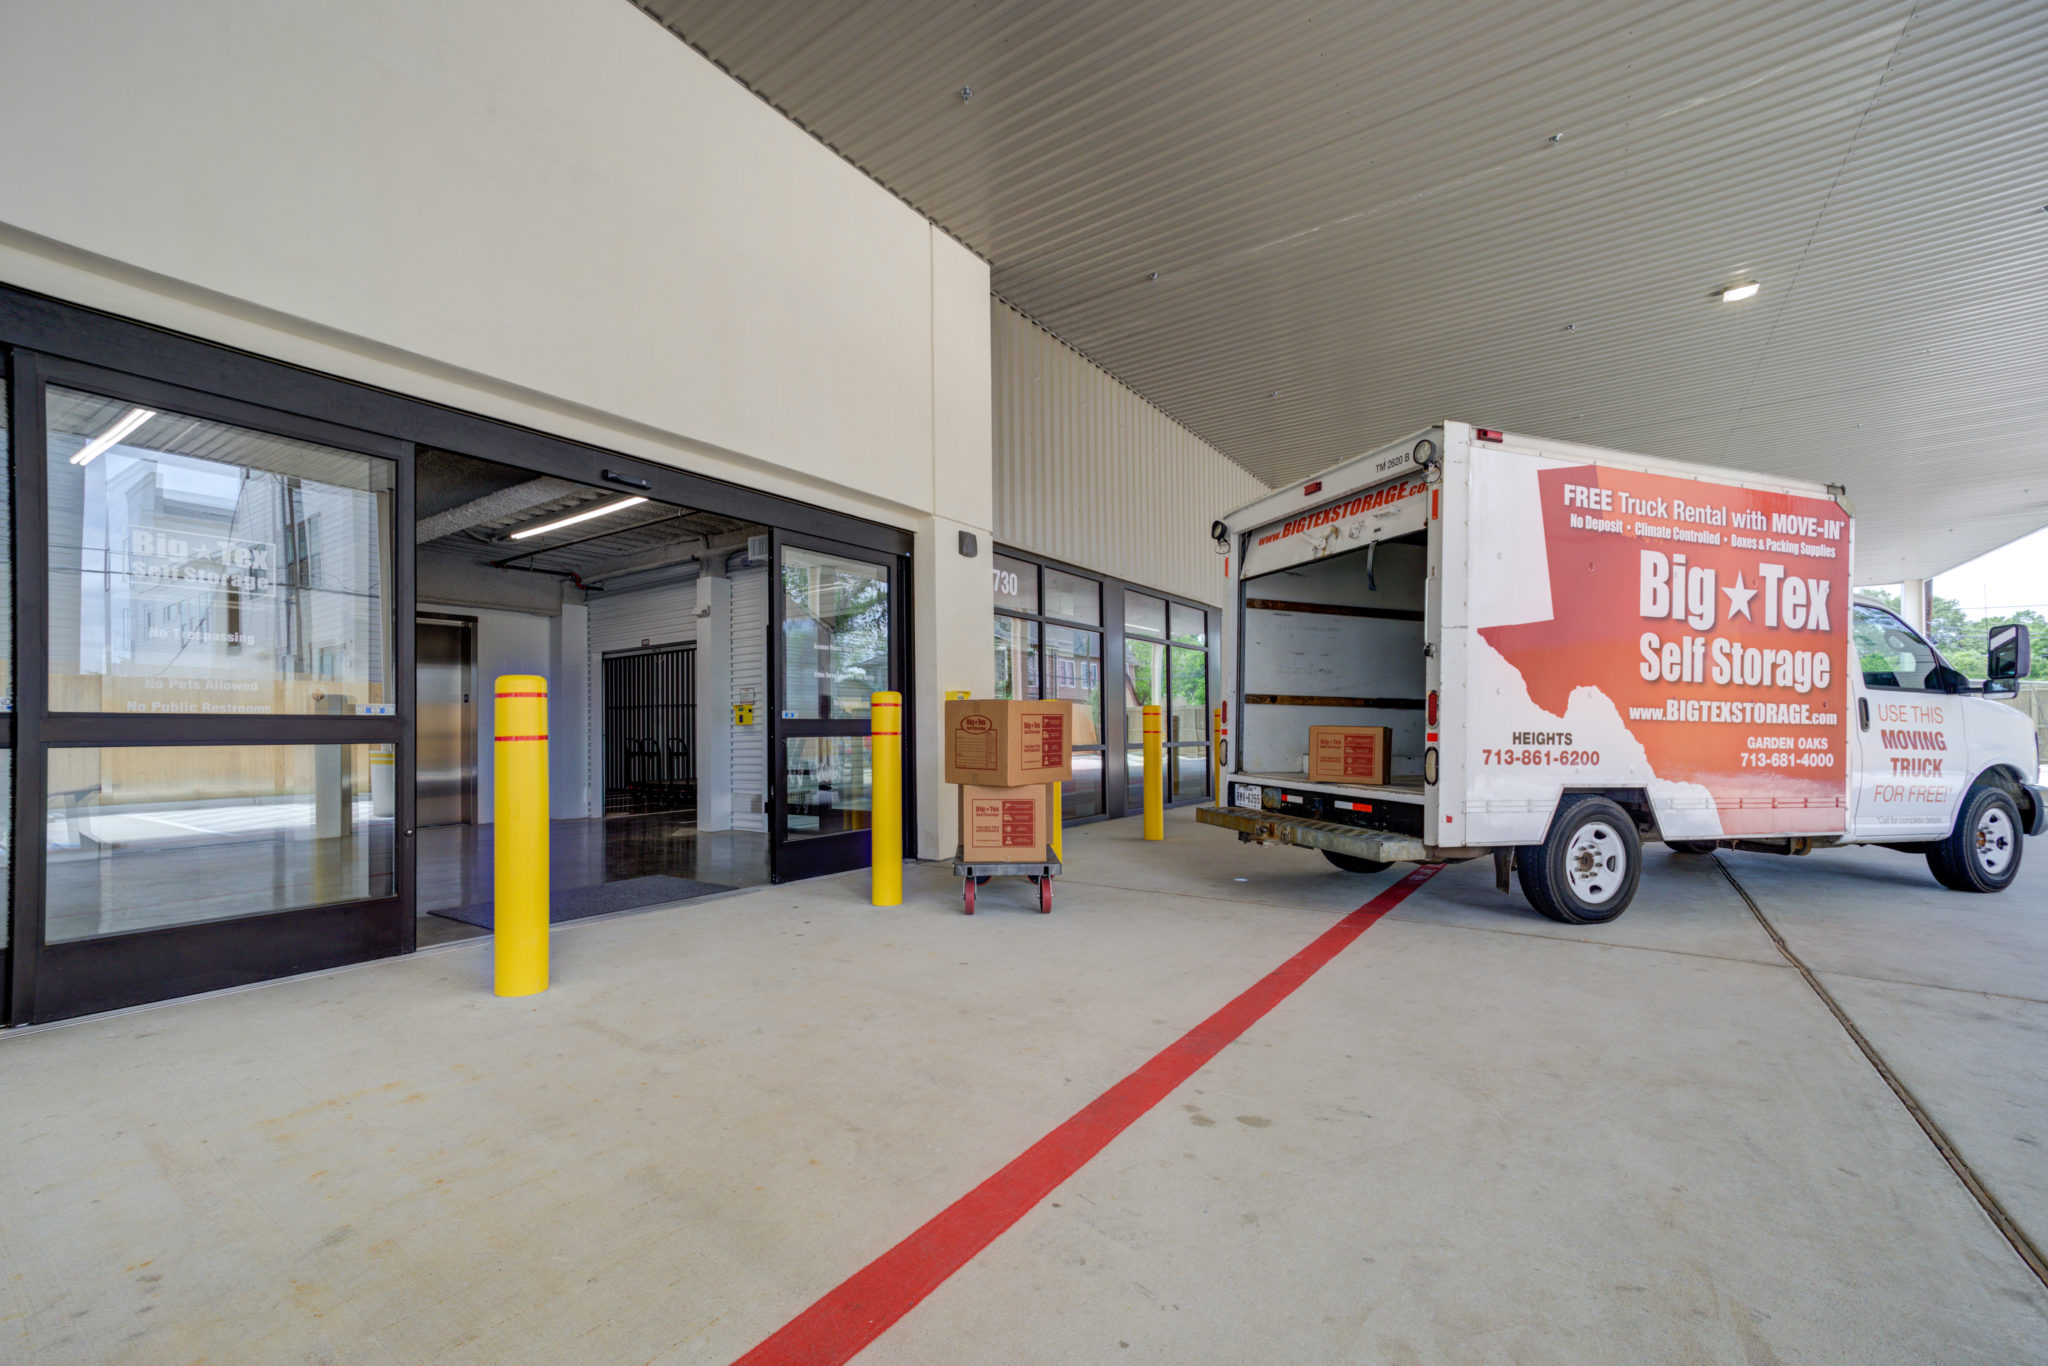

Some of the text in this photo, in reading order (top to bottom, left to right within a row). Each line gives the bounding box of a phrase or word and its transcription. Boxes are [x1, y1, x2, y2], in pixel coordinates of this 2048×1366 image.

[1376, 452, 1410, 473] TM 2620 B
[1258, 480, 1429, 546] www.BIGTEXSTORAGE.co
[1564, 484, 1613, 512] FREE
[1617, 491, 1668, 519] Truck
[1673, 499, 1727, 527] Rental
[1731, 509, 1767, 532] with
[1570, 513, 1836, 559] No Deposit Climate Controlled Boxes & Packing Supplies
[133, 530, 268, 570] Big Tex
[132, 560, 269, 592] Self Storage
[993, 569, 1018, 596] 730
[1639, 549, 1831, 632] Big Tex
[149, 626, 256, 645] No Trespassing
[1639, 632, 1831, 693] Self Storage
[145, 679, 259, 692] No Pets Allowed
[126, 701, 272, 714] No Public Restrooms
[1629, 700, 1838, 726] www.BIGTEXSTORAGE.com
[1877, 704, 1944, 724] USE THIS
[1512, 731, 1573, 747] HEIGHTS
[1747, 736, 1829, 751] GARDEN OAKS
[1880, 729, 1948, 751] MOVING
[1482, 749, 1600, 767] 713-861-6200
[1740, 752, 1835, 768] 713-681-4000
[1890, 757, 1944, 778] TRUCK
[1873, 785, 1905, 803] FOR
